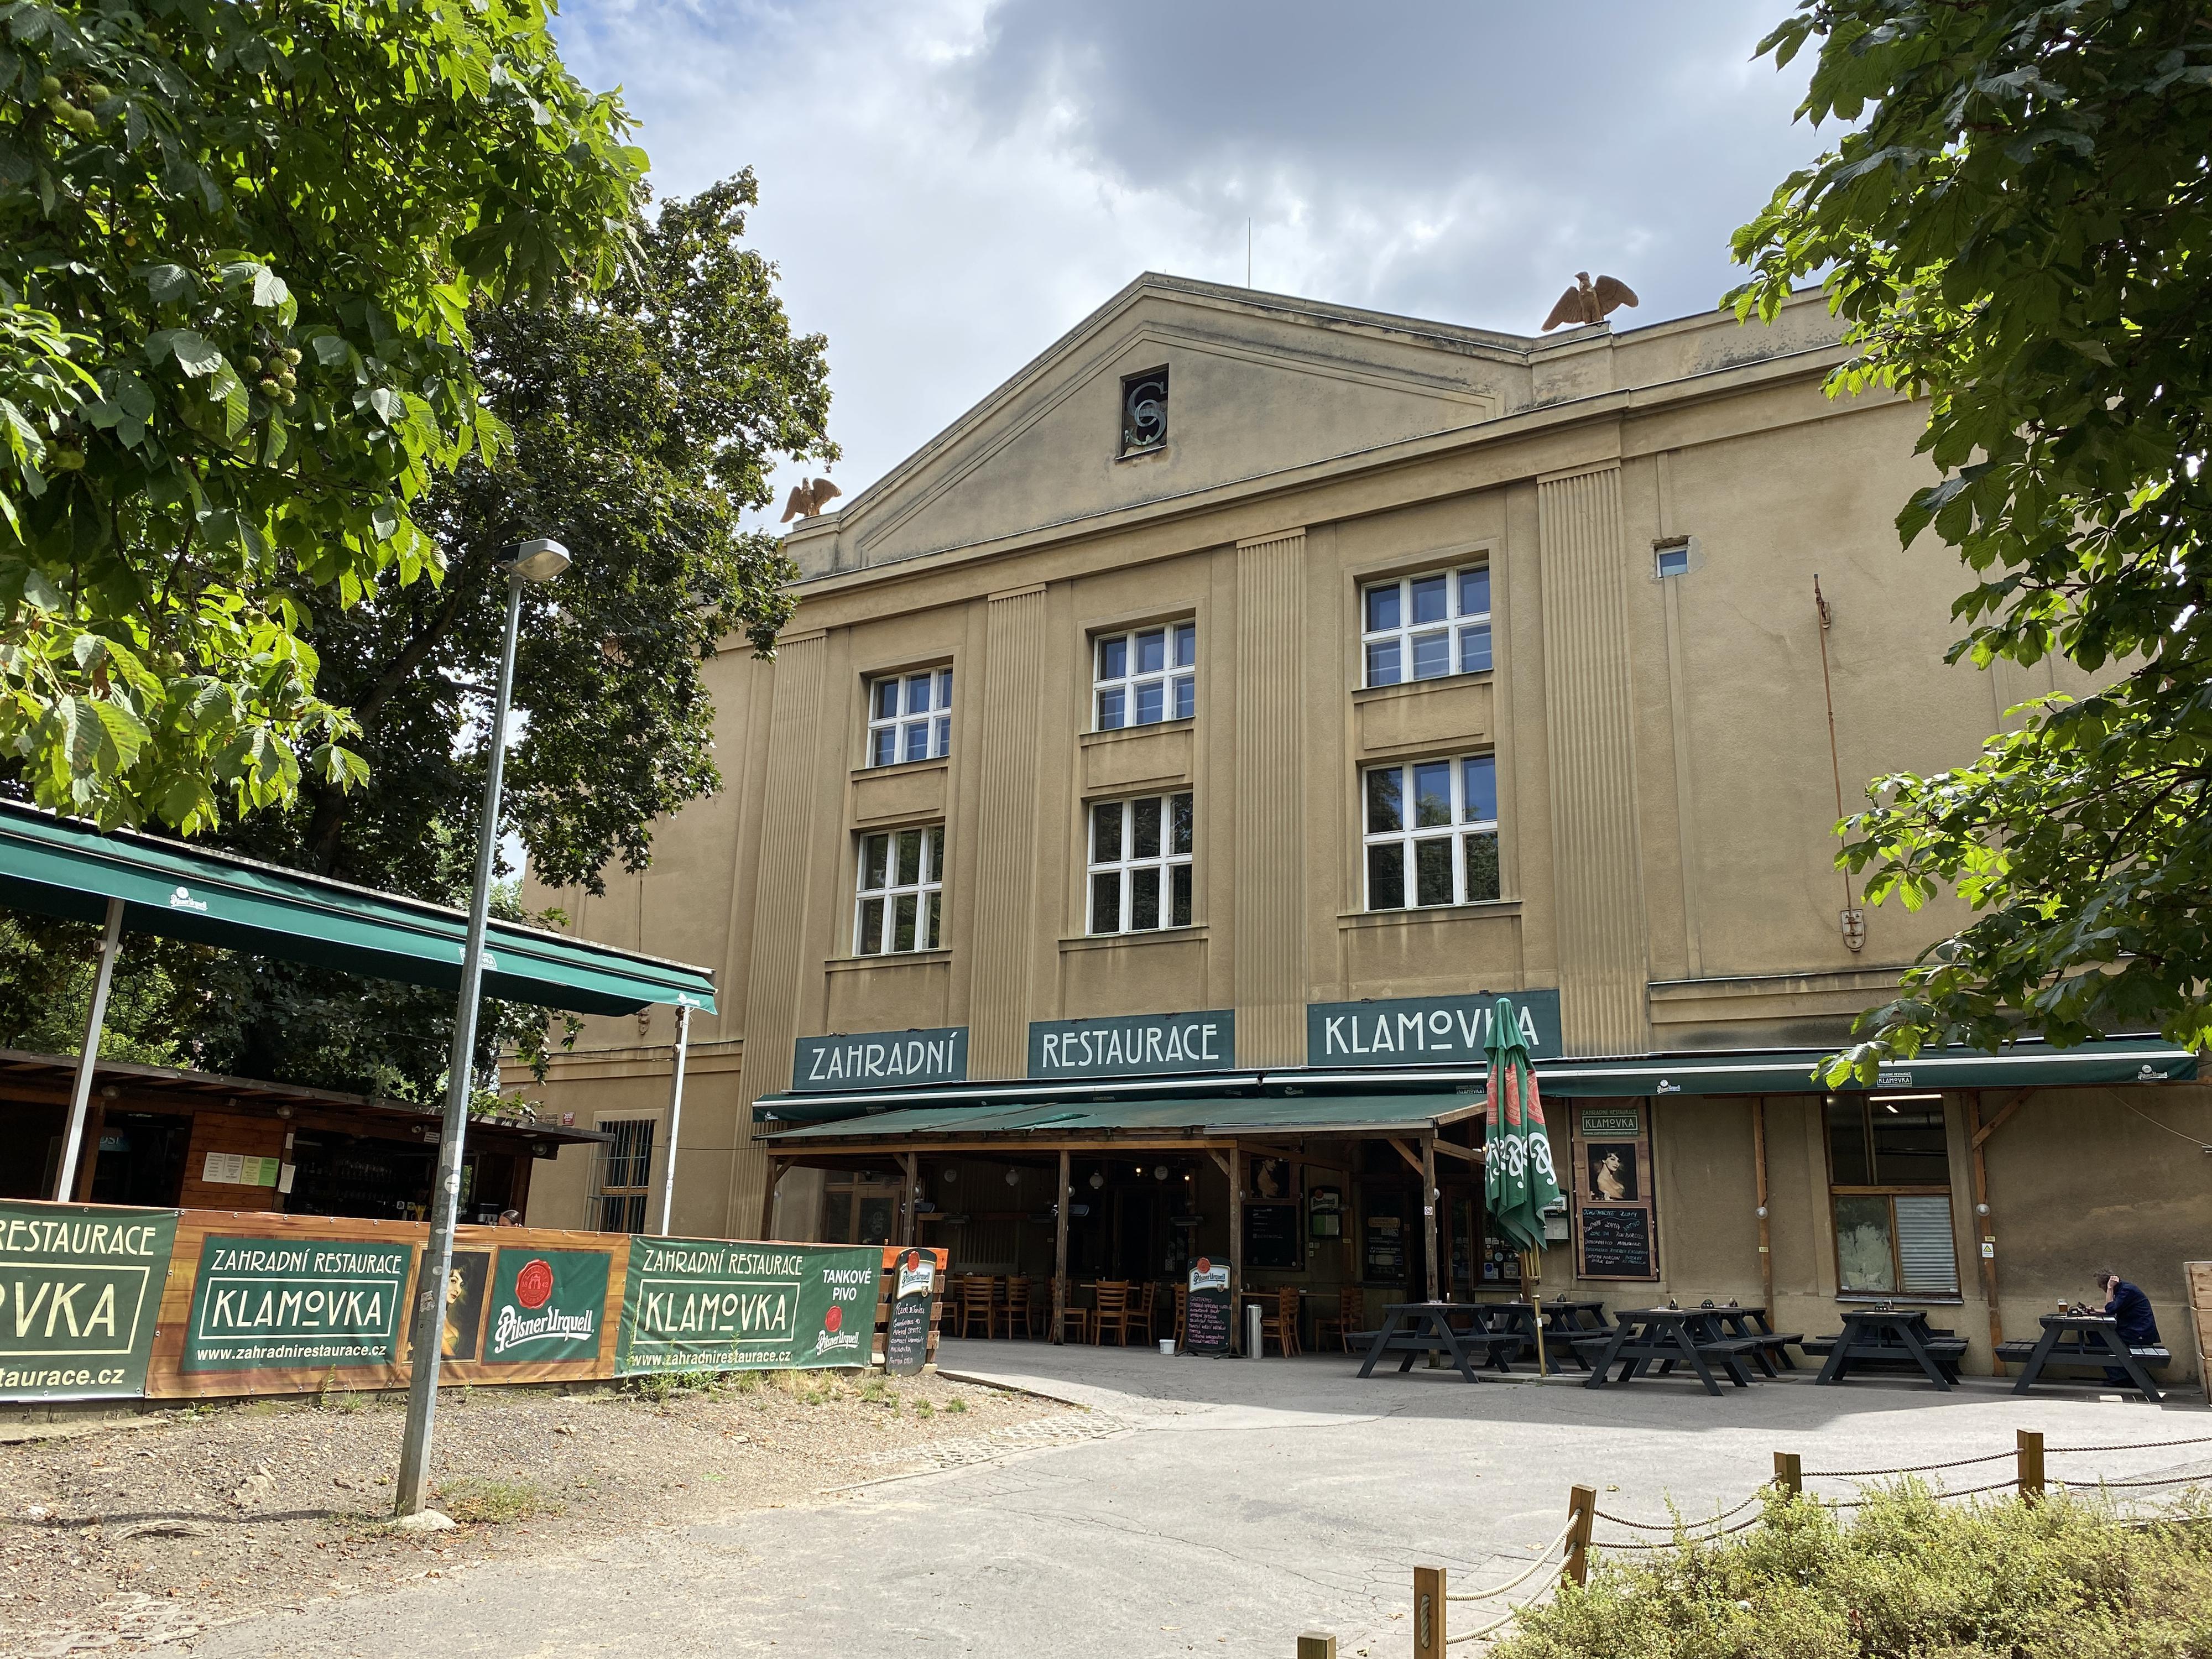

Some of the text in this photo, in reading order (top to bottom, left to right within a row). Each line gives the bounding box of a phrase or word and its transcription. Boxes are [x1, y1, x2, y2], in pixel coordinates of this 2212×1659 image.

[808, 1031, 957, 1080] ZAHRADNÍ
[1042, 1024, 1219, 1067] RESTAURACE
[1585, 1118, 1634, 1128] KLAMOVKA
[210, 1248, 401, 1274] ZAHRADNÍ RESTAURACE
[642, 1248, 802, 1275] ZAHRADNÍ RESTAURACE
[823, 1267, 872, 1284] TANKOVÉ
[832, 1287, 857, 1301] PIVO
[0, 1282, 114, 1337] VKA
[212, 1290, 381, 1327] KLAMOVKA
[644, 1292, 786, 1331] KLAMOVKA
[494, 1305, 593, 1354] Pilsner Urquell
[197, 1344, 387, 1360] www.zahradnirestaurace.cz
[816, 1330, 859, 1356] Pilsner Urquell
